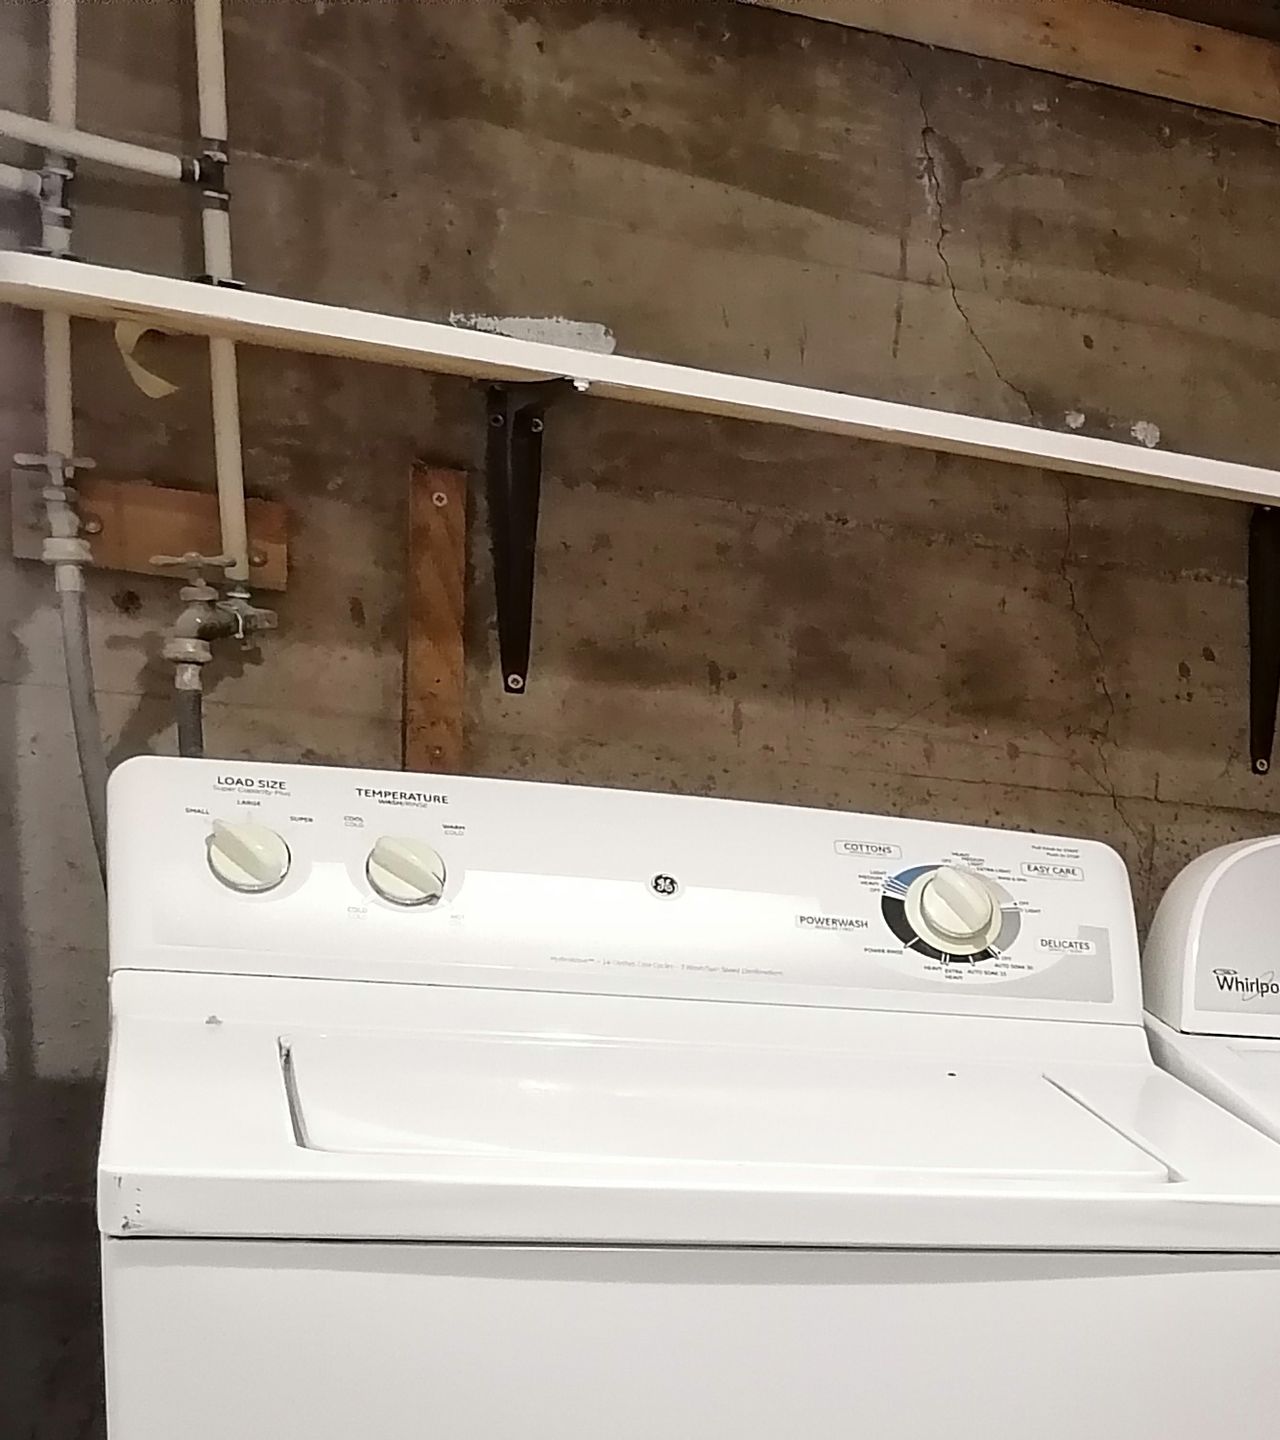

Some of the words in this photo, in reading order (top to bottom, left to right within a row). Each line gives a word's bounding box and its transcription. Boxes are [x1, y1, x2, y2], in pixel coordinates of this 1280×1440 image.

[213, 785, 236, 793] Super
[217, 776, 255, 789] LOAD
[258, 778, 287, 791] SIZE
[355, 788, 449, 804] TEMPERATURE
[185, 807, 210, 815] SMALL
[844, 842, 892, 854] COTTONS
[1027, 864, 1050, 874] EASY
[1052, 865, 1078, 876] CARE
[799, 916, 869, 929] POWERWASH
[1040, 938, 1090, 951] DELICATES
